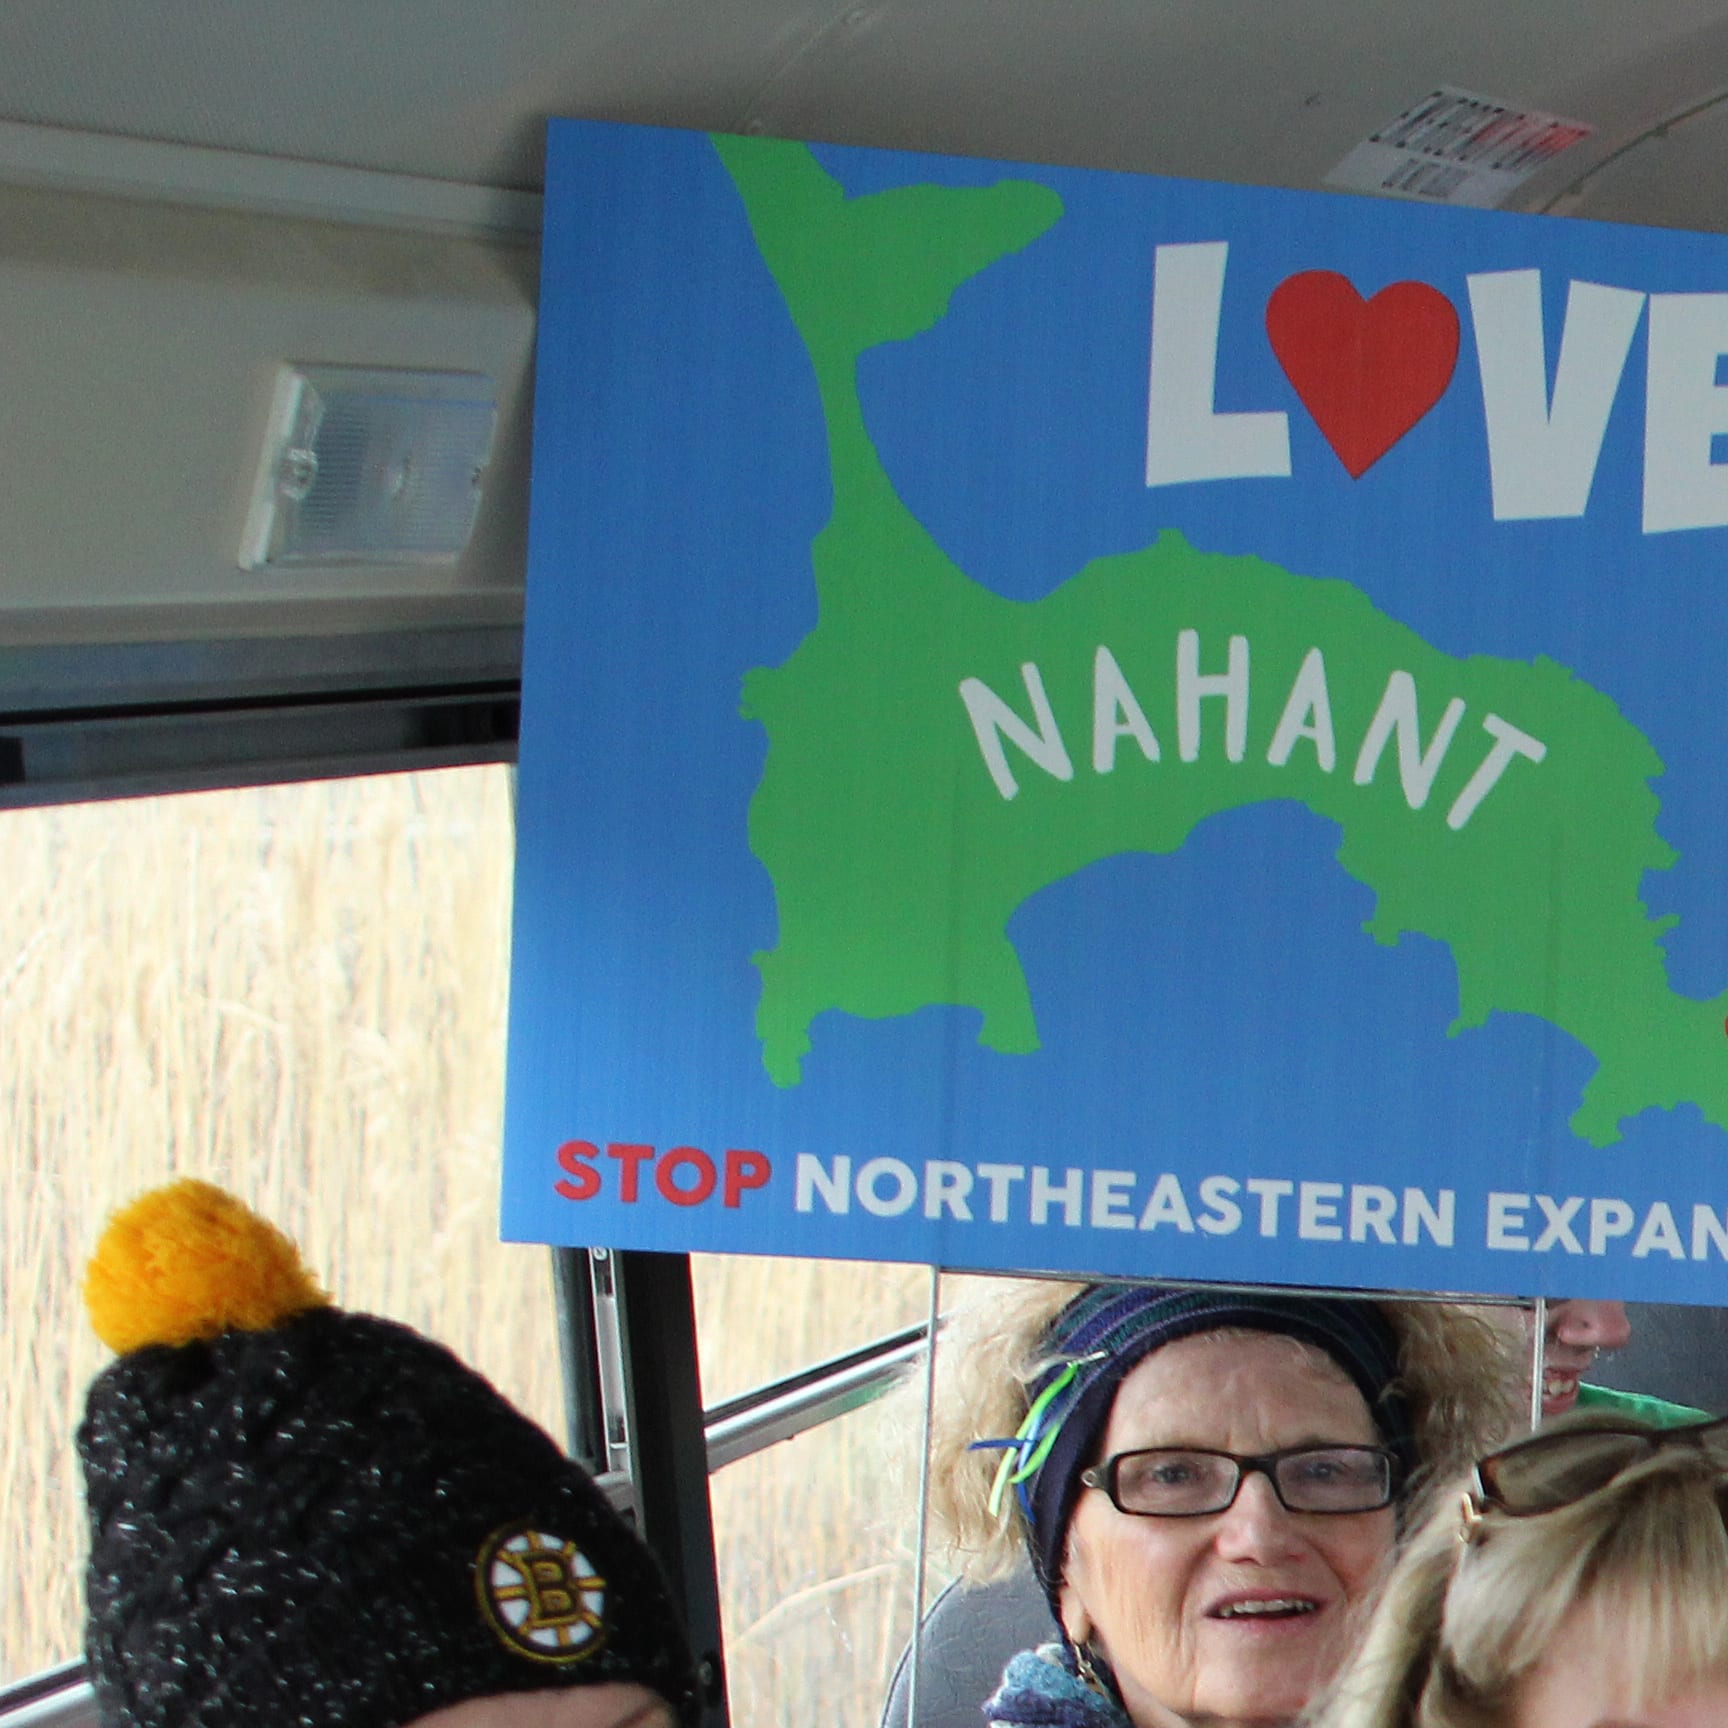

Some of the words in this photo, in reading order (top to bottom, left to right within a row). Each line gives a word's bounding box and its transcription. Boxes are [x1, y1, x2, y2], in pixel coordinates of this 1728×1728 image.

[958, 628, 1547, 830] NAHANT
[554, 1140, 772, 1209] STOP
[794, 1152, 1455, 1247] NORTHEASTERN
